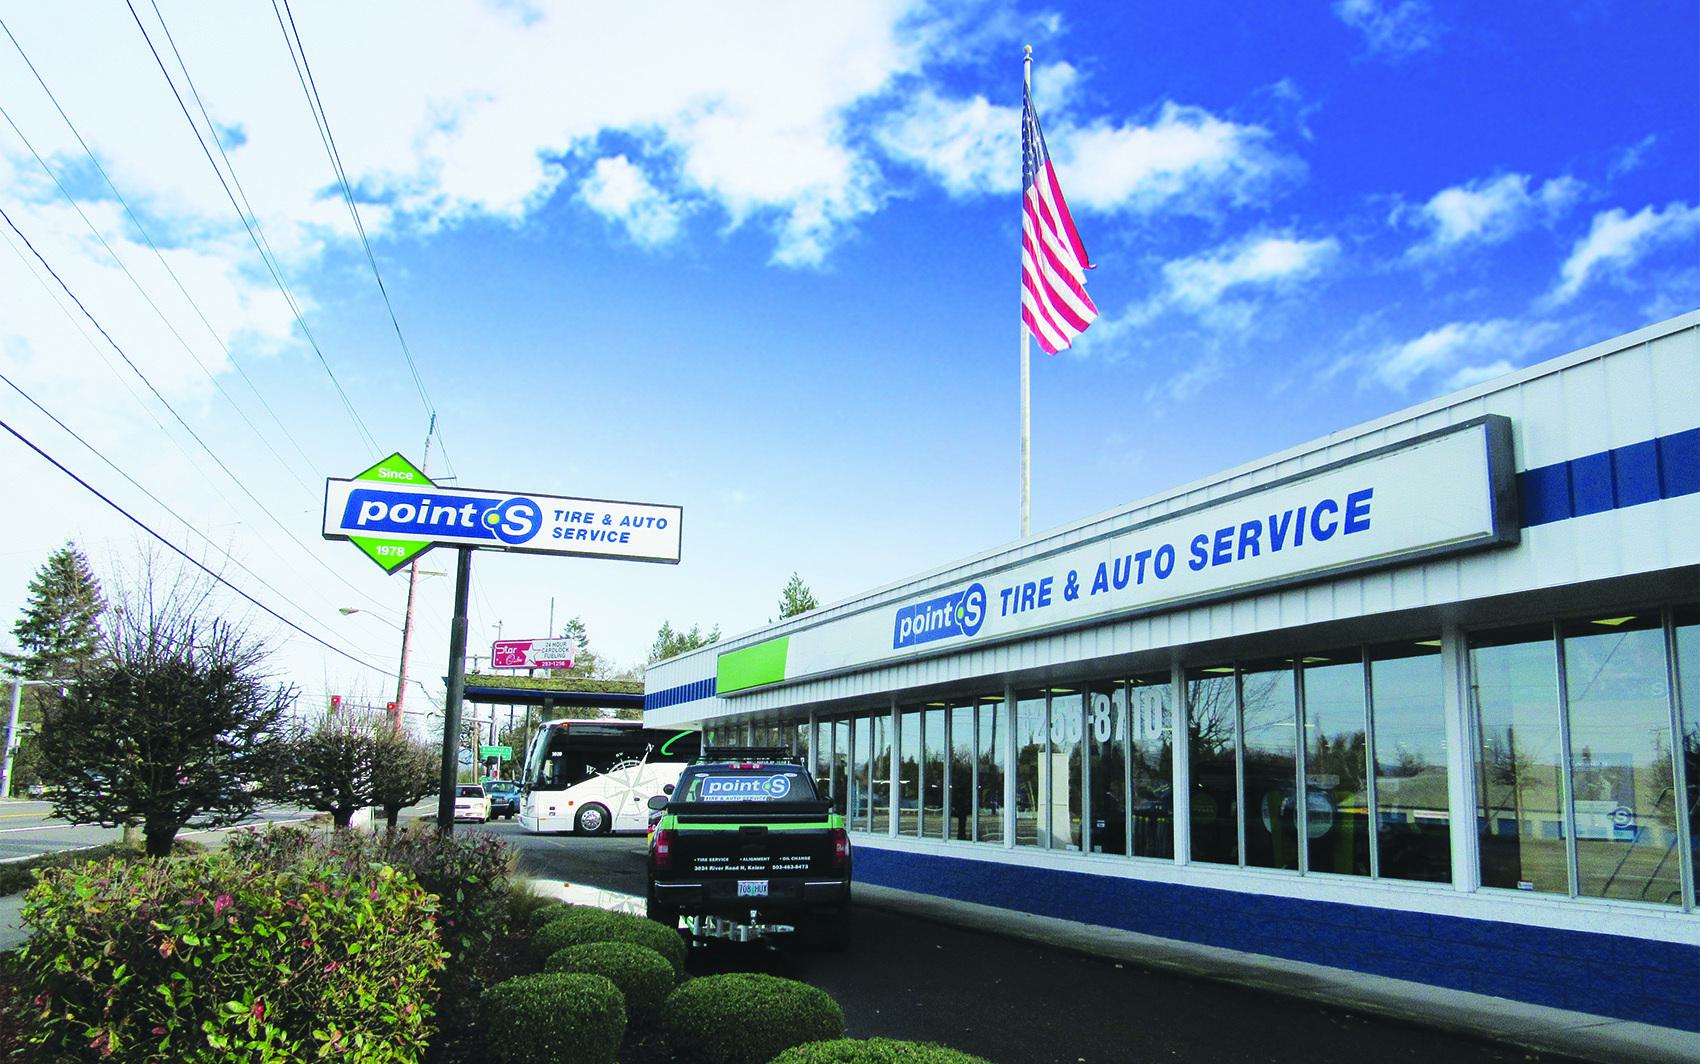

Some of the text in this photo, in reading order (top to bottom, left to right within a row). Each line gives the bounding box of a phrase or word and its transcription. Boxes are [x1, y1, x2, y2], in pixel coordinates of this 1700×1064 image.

[377, 467, 414, 481] Since
[357, 498, 479, 529] point
[553, 509, 668, 530] TIRE & AUTO
[552, 527, 631, 544] SERVICE
[375, 544, 406, 558] 1978
[899, 602, 953, 645] point
[1000, 575, 1054, 617] TIRE
[1063, 569, 1081, 602] &
[1090, 543, 1176, 596] AUTO
[1187, 487, 1375, 572] SERVICE
[708, 779, 760, 794] point
